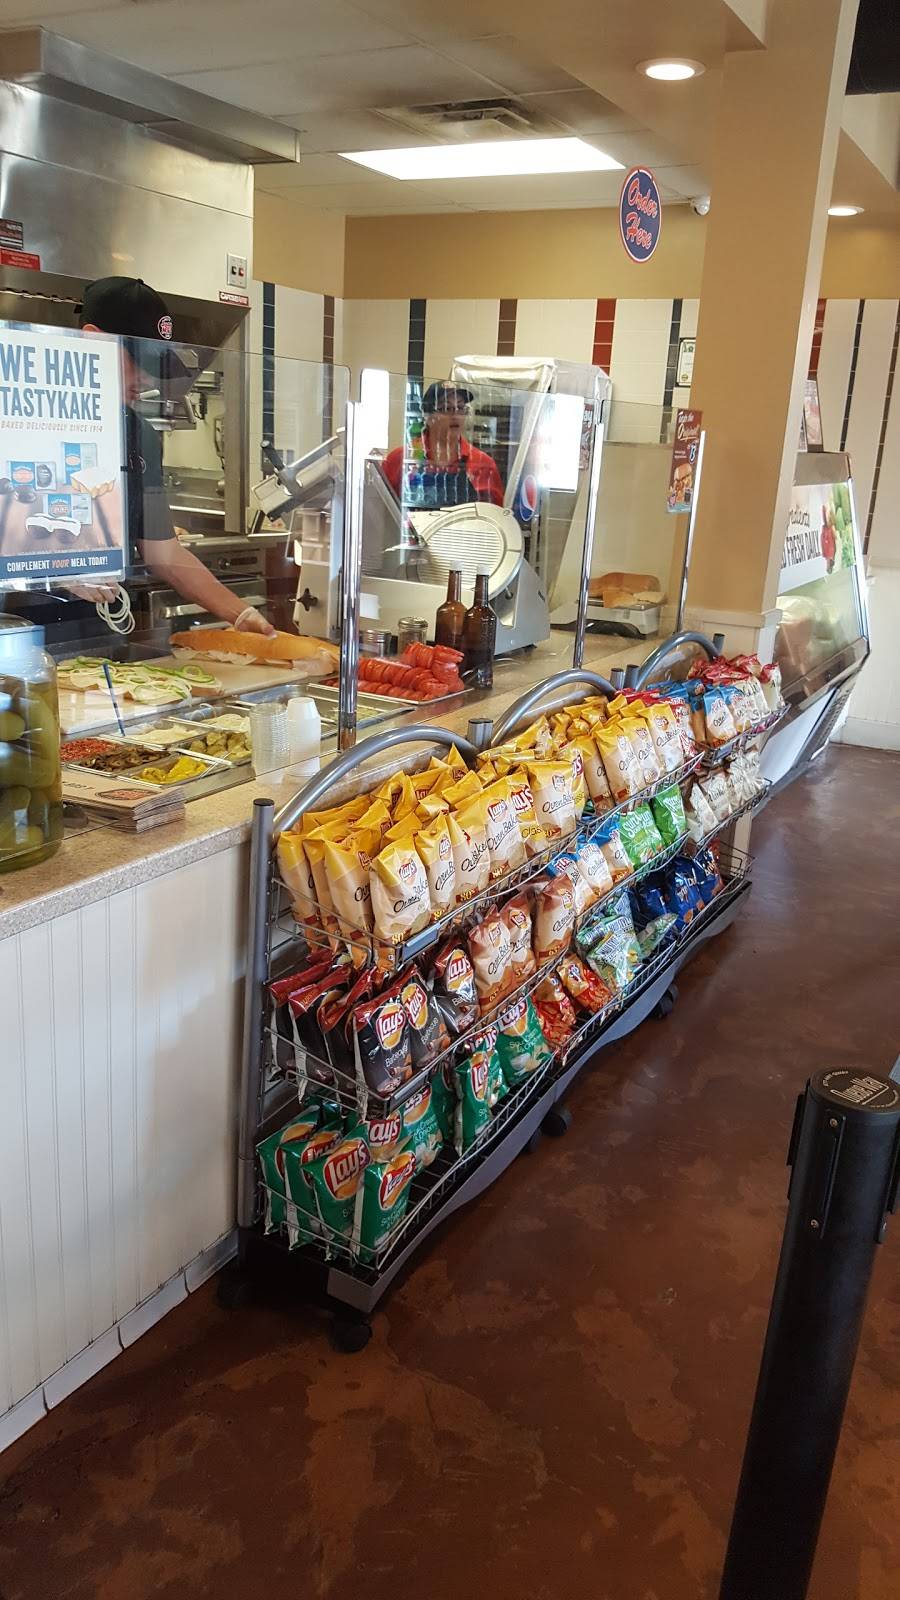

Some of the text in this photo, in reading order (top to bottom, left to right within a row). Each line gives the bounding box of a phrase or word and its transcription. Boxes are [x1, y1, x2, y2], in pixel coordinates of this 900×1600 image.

[628, 178, 657, 218] Order
[626, 212, 652, 249] Here
[0, 343, 101, 389] WE HAVE
[0, 386, 102, 421] TASTYKAKE
[7, 556, 108, 572] COMPLEMENT YOUR MEAL TODAY!
[785, 533, 806, 567] FRESH
